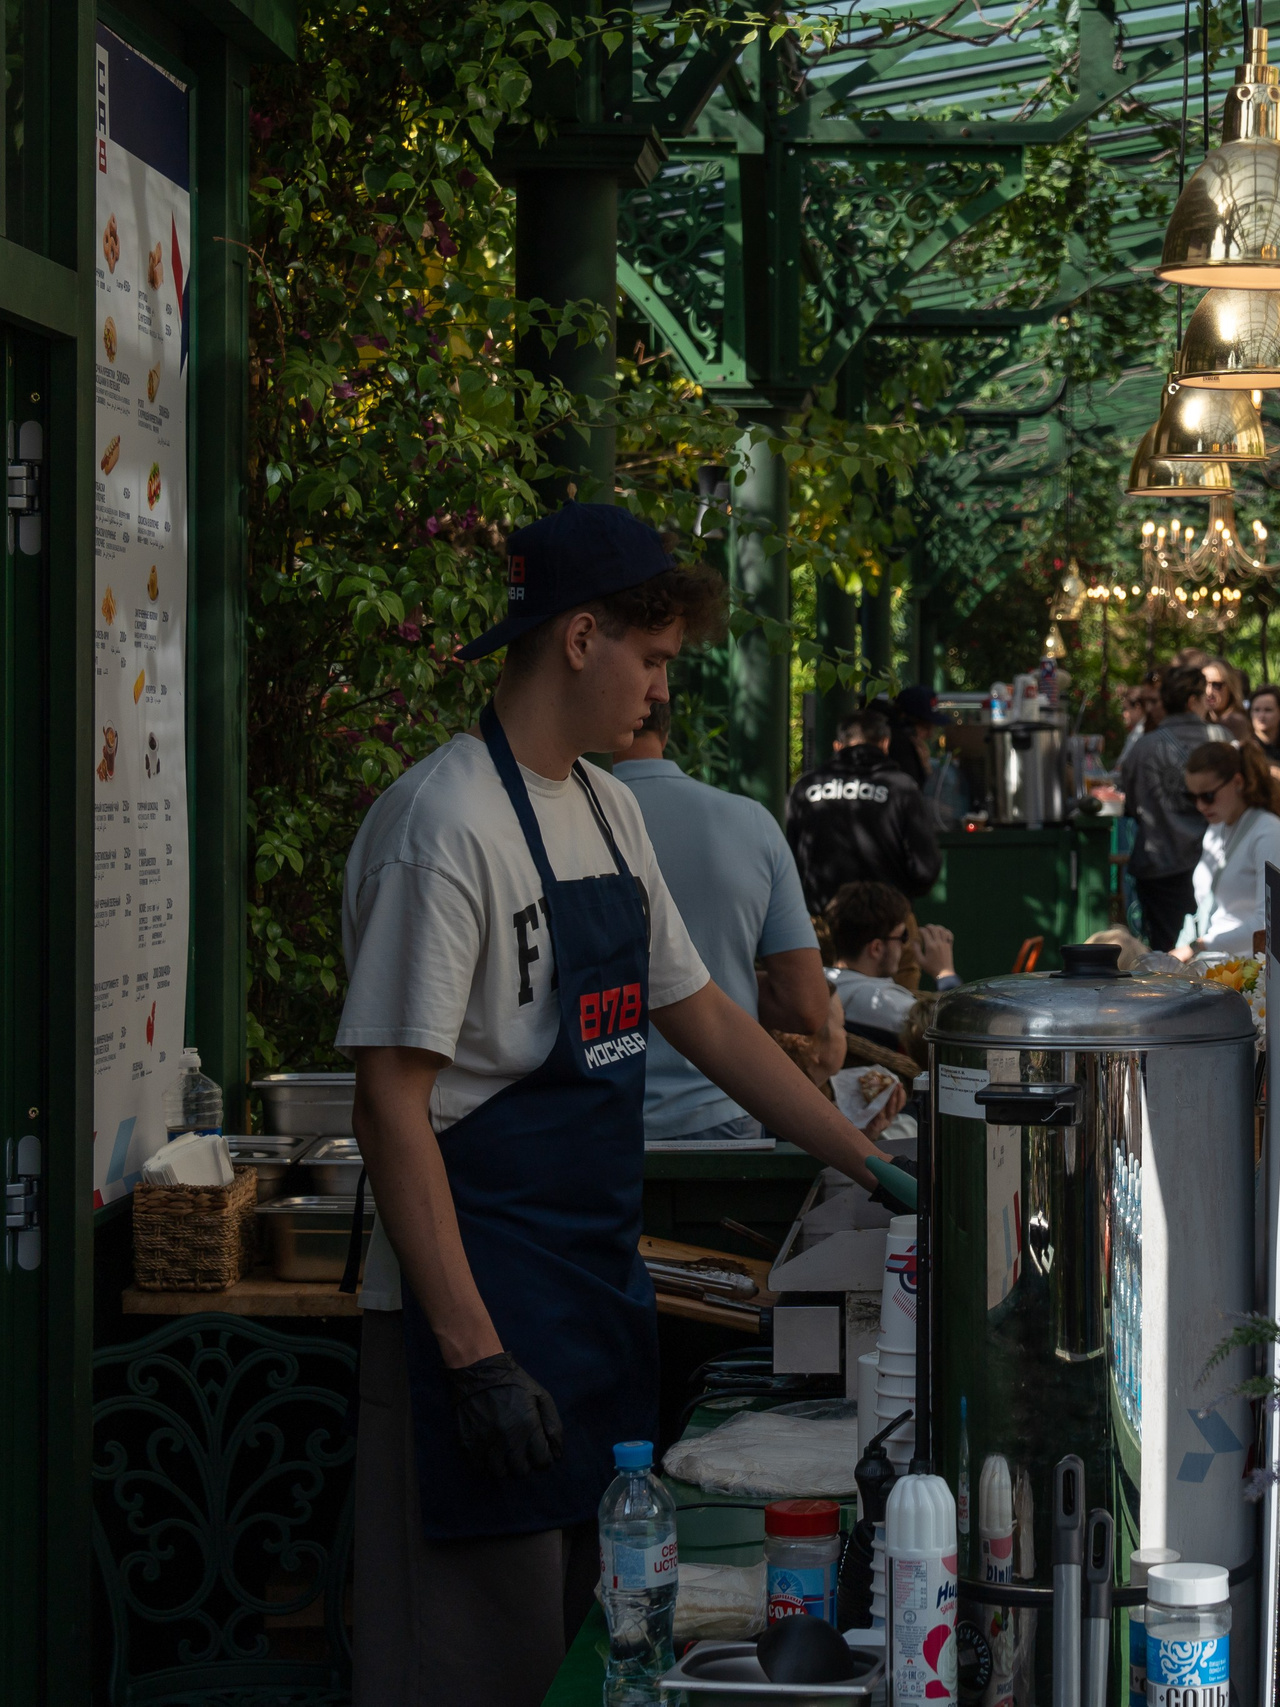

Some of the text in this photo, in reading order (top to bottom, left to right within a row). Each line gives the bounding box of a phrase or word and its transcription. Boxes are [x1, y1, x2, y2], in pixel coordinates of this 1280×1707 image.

[805, 778, 889, 803] adidas
[579, 982, 642, 1042] 878
[584, 1032, 647, 1069] МОСКВА
[1166, 1685, 1226, 1707] СОЛЬ
